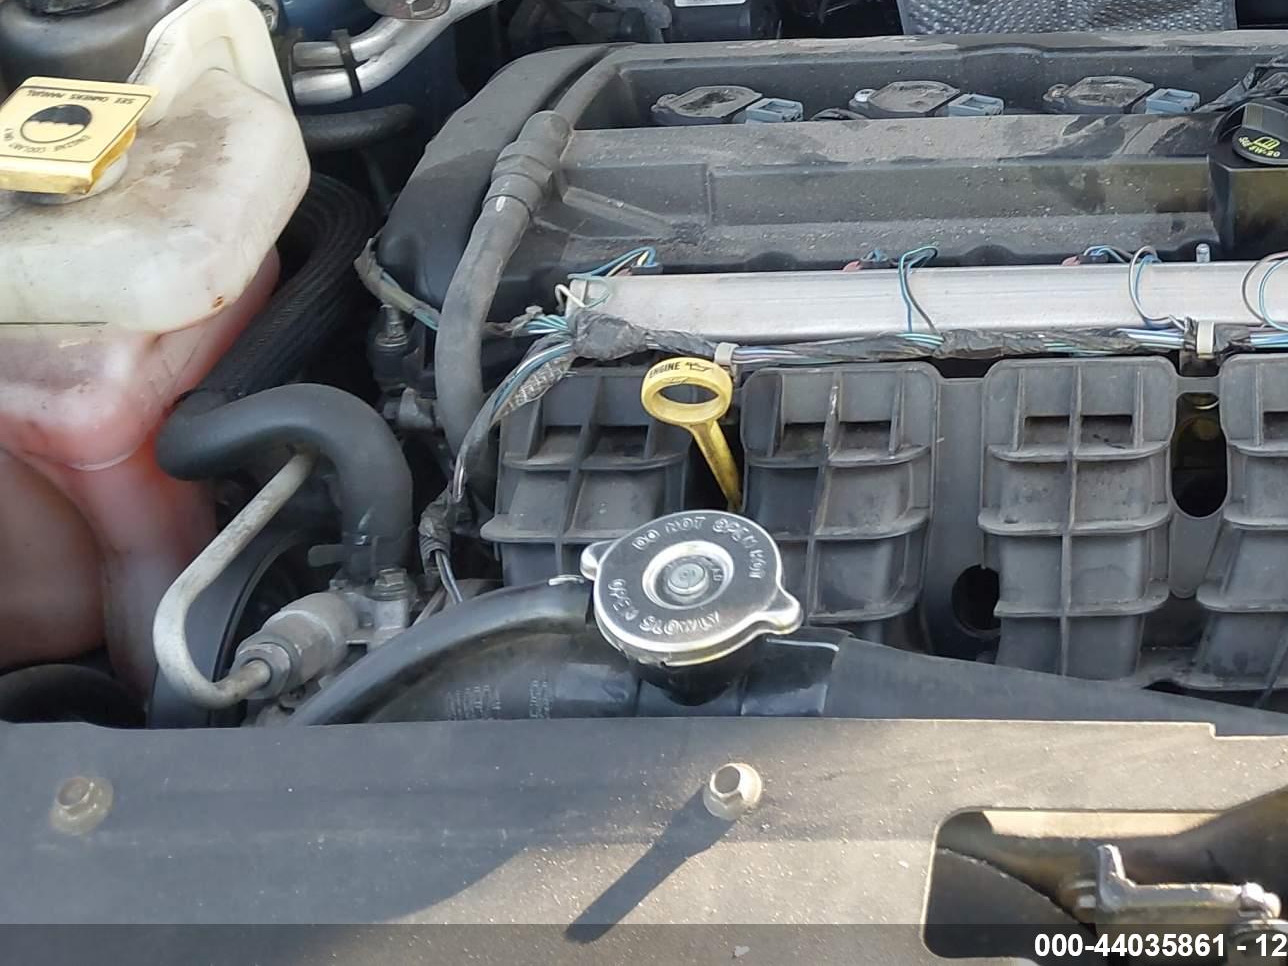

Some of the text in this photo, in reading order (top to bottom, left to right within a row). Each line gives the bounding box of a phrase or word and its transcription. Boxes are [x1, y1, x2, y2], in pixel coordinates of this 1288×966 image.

[114, 97, 136, 105] SEE
[649, 361, 681, 379] ENGINE
[632, 529, 660, 550] DO
[666, 516, 706, 534] NOT
[712, 518, 758, 549] OPEN
[749, 548, 767, 579] HOT
[608, 578, 720, 635] OPEN SLOWLY
